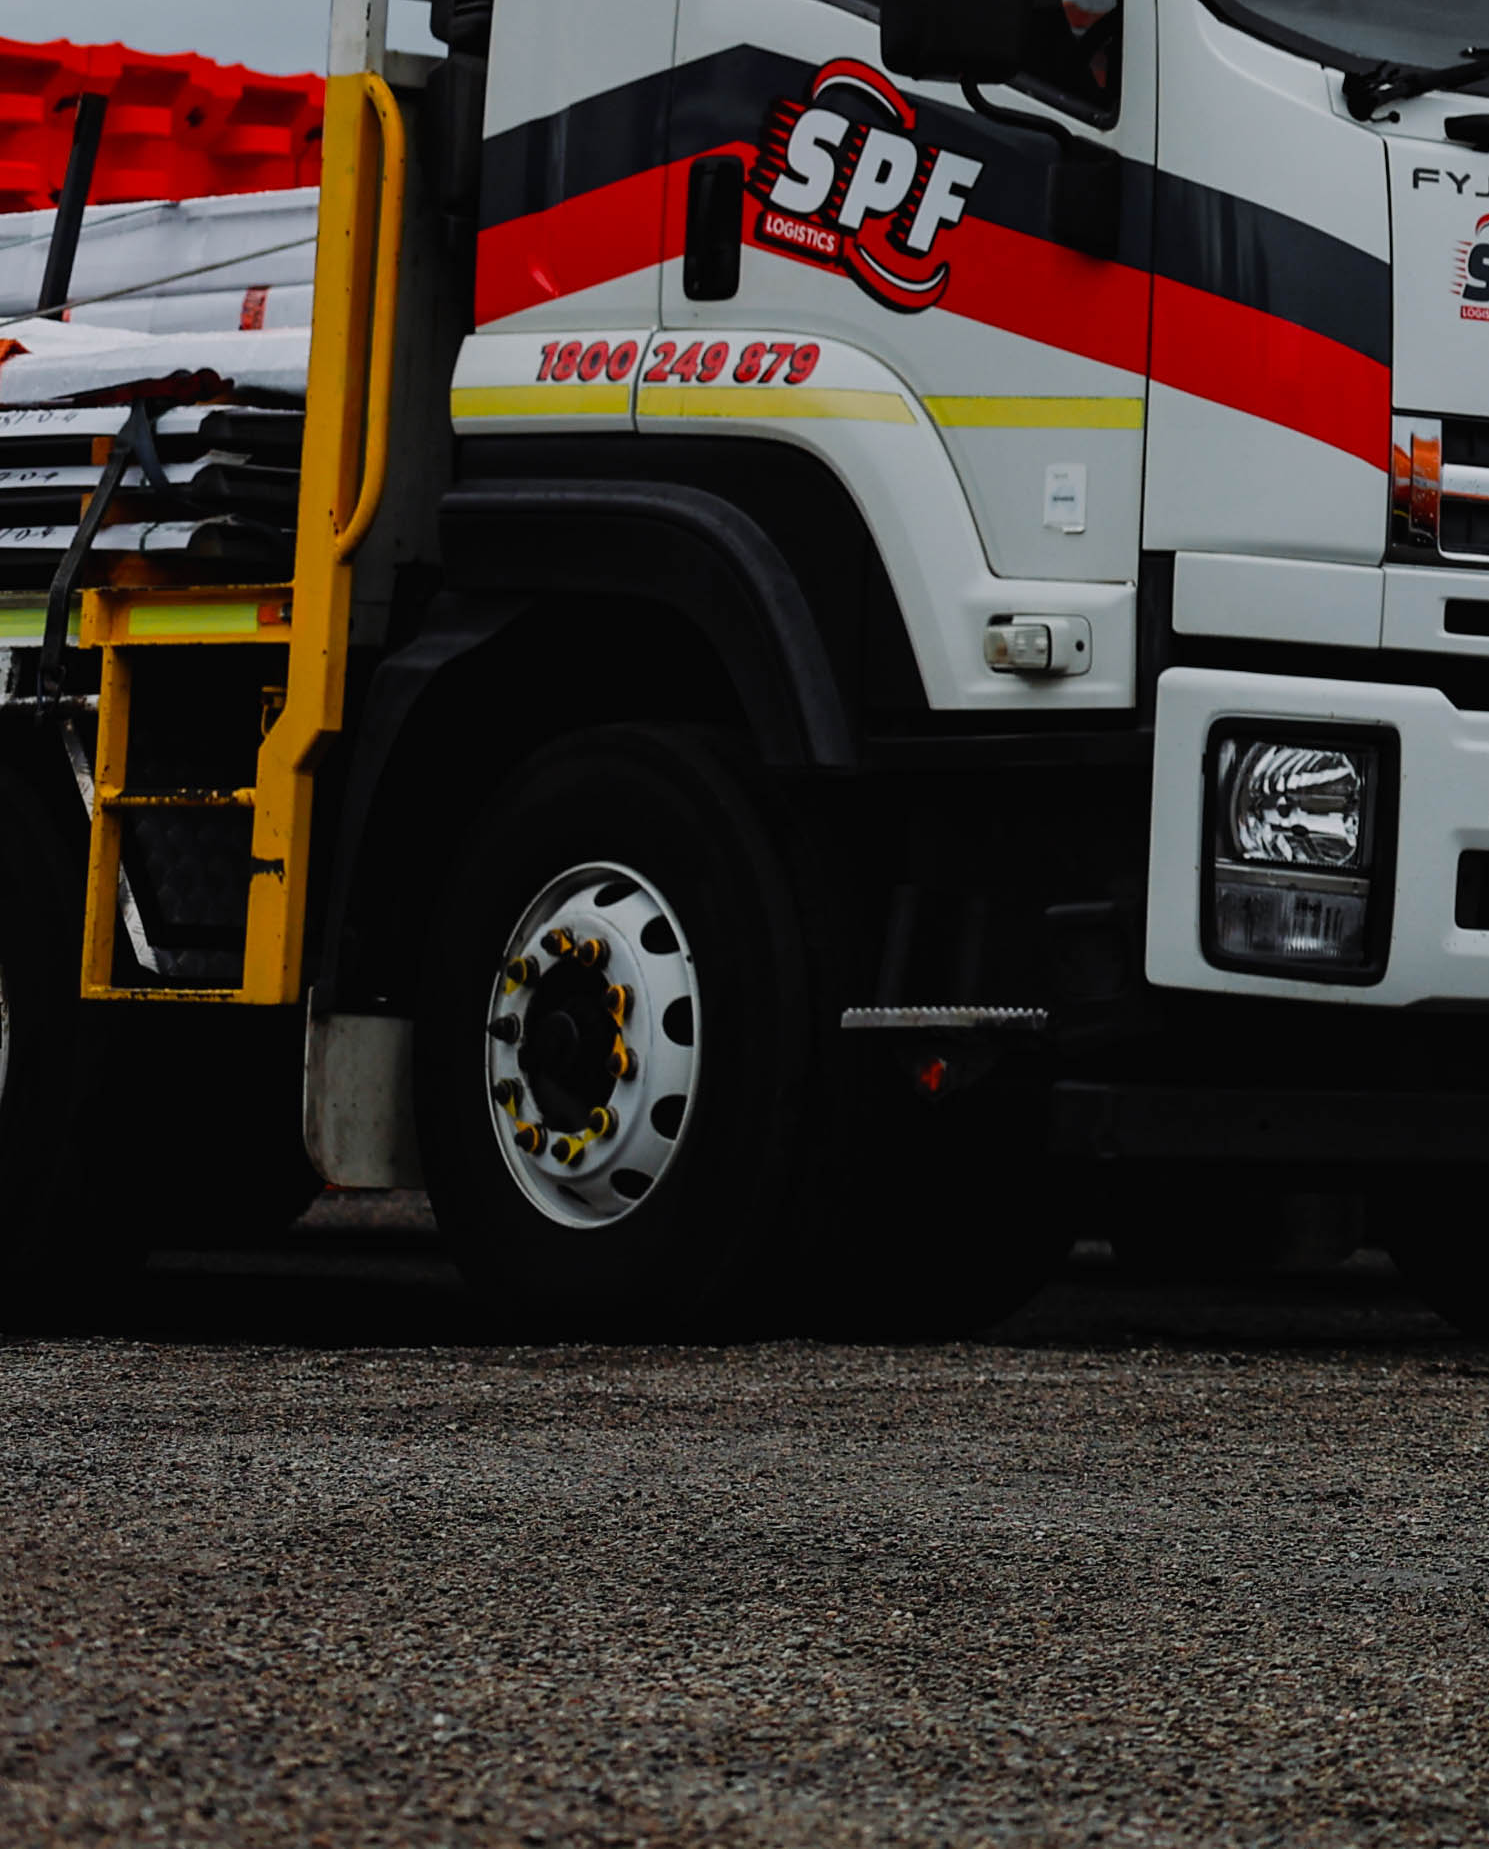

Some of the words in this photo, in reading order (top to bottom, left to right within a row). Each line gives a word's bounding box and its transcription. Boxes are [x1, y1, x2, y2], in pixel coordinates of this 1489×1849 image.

[770, 108, 983, 251] SPF
[766, 215, 835, 252] LOGISTICS
[536, 340, 639, 382] 1800
[644, 341, 729, 383] 249
[733, 343, 820, 384] 879
